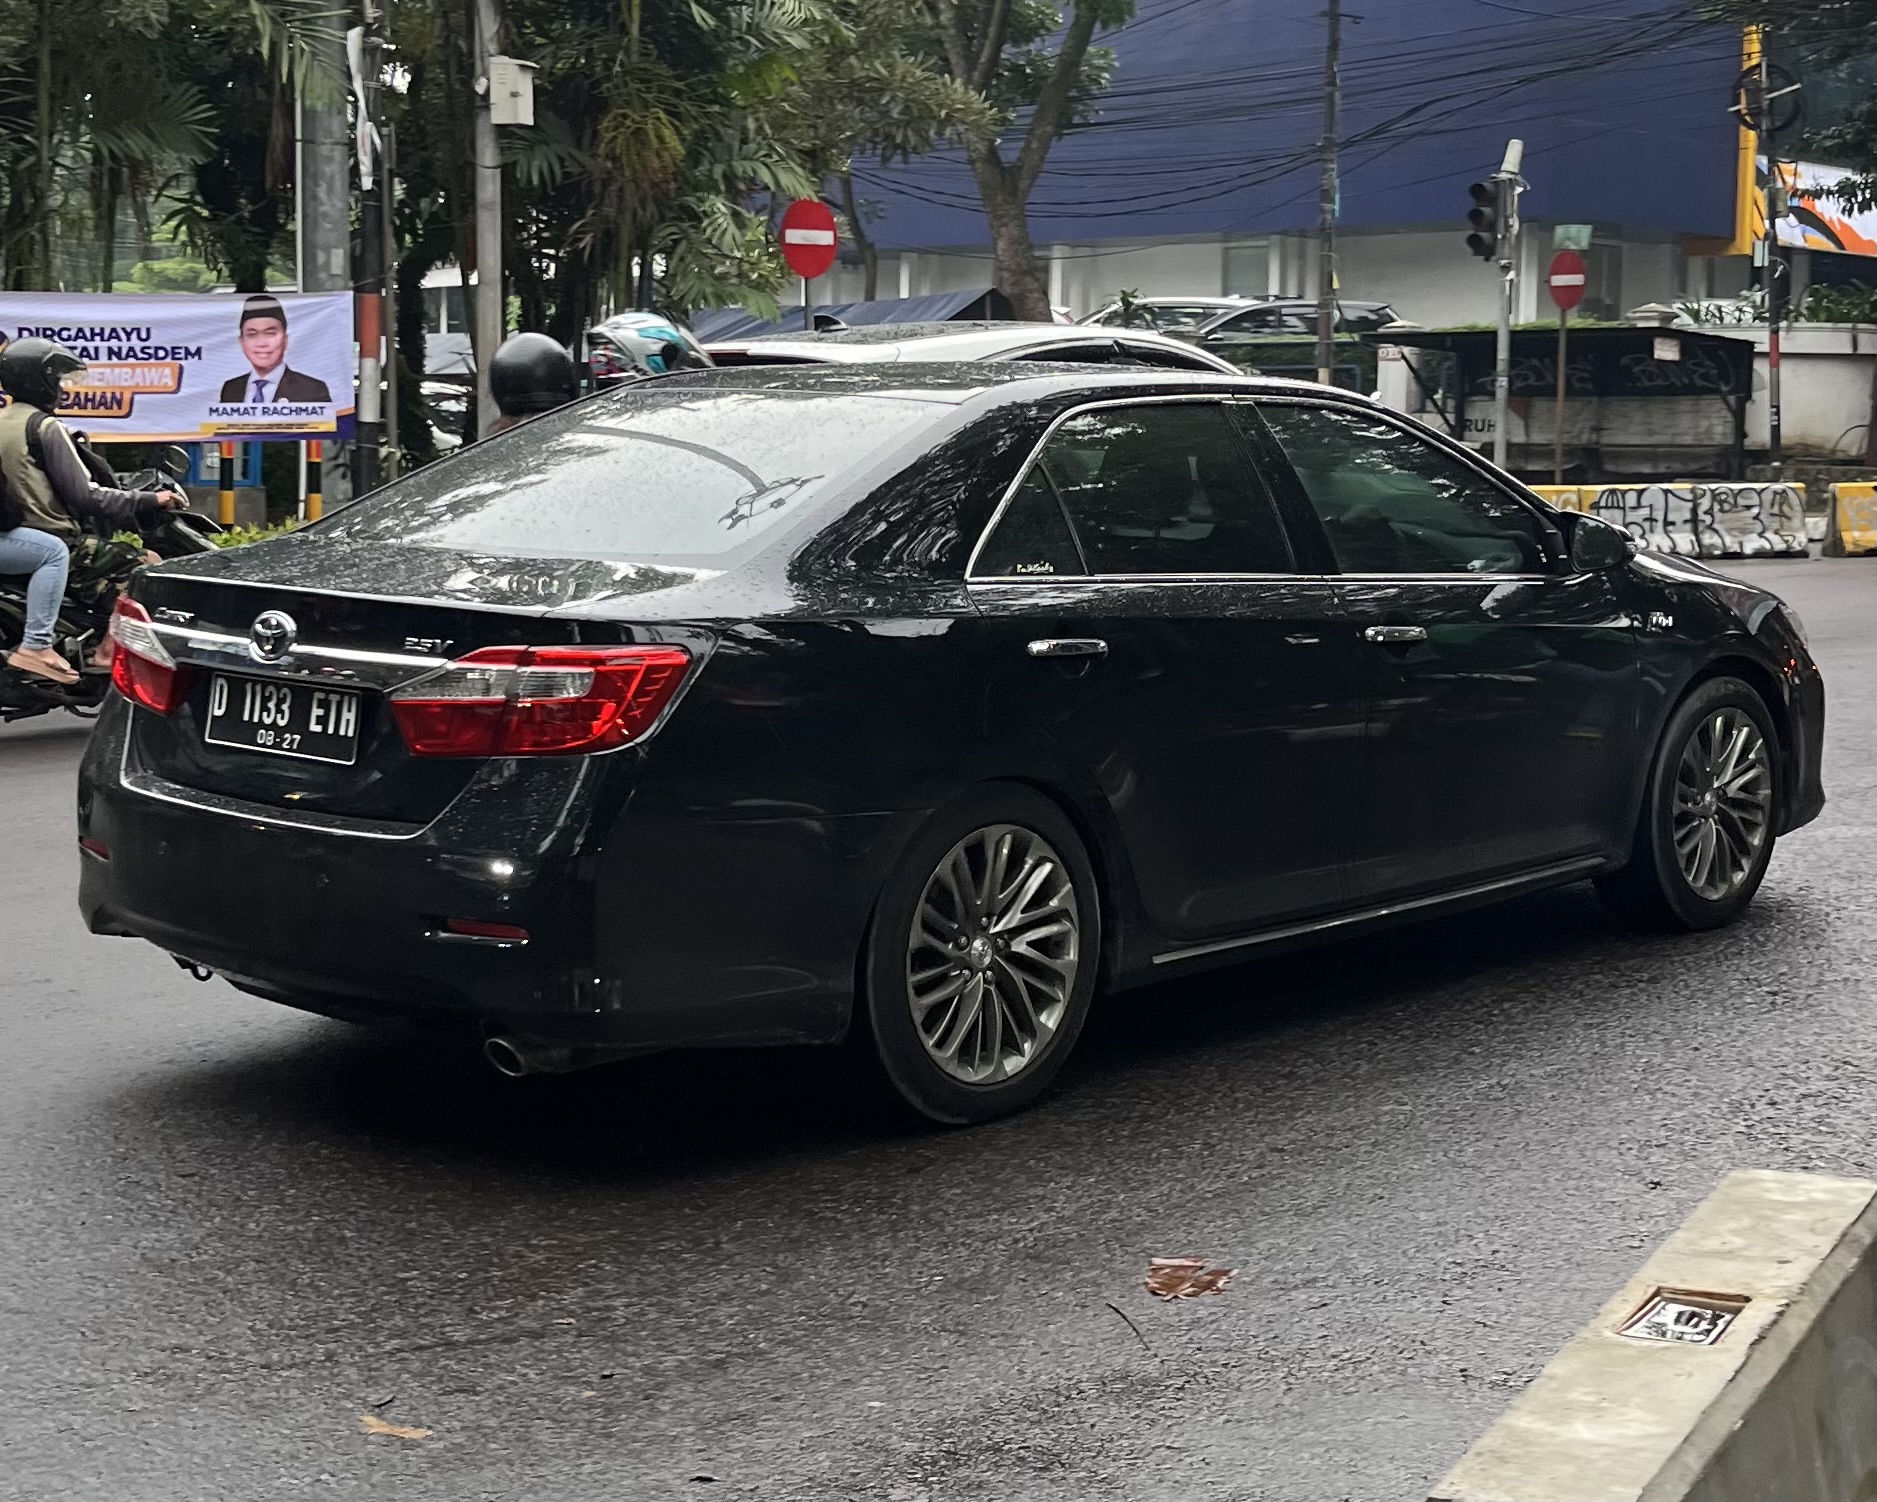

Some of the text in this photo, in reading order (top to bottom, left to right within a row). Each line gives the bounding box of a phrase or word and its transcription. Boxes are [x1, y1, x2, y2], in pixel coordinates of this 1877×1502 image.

[17, 326, 152, 342] DIRGAHAYU
[107, 346, 202, 361] NASDEM
[209, 405, 326, 417] MAMAT RACHMAT
[213, 677, 358, 738] D 1133 ETH
[256, 729, 301, 749] 08-27
